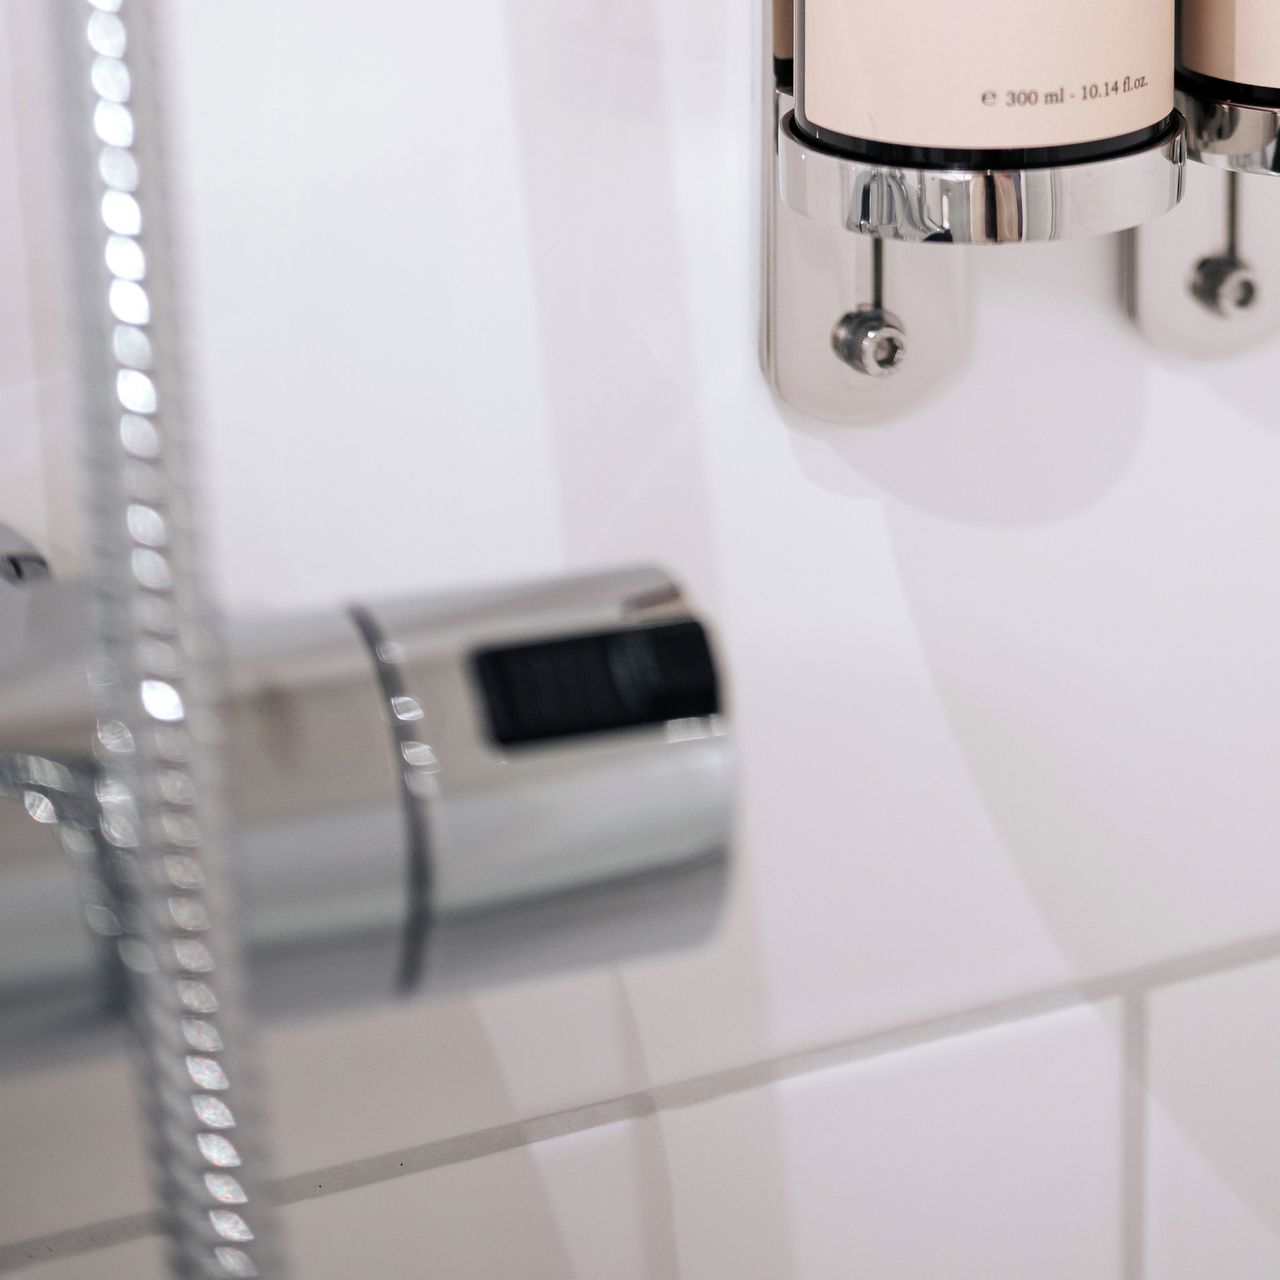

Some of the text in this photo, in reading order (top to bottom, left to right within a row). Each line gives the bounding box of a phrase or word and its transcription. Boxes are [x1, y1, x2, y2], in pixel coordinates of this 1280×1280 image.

[1005, 91, 1039, 107] 300
[1044, 87, 1064, 105] ml
[1081, 80, 1119, 101] 10.14
